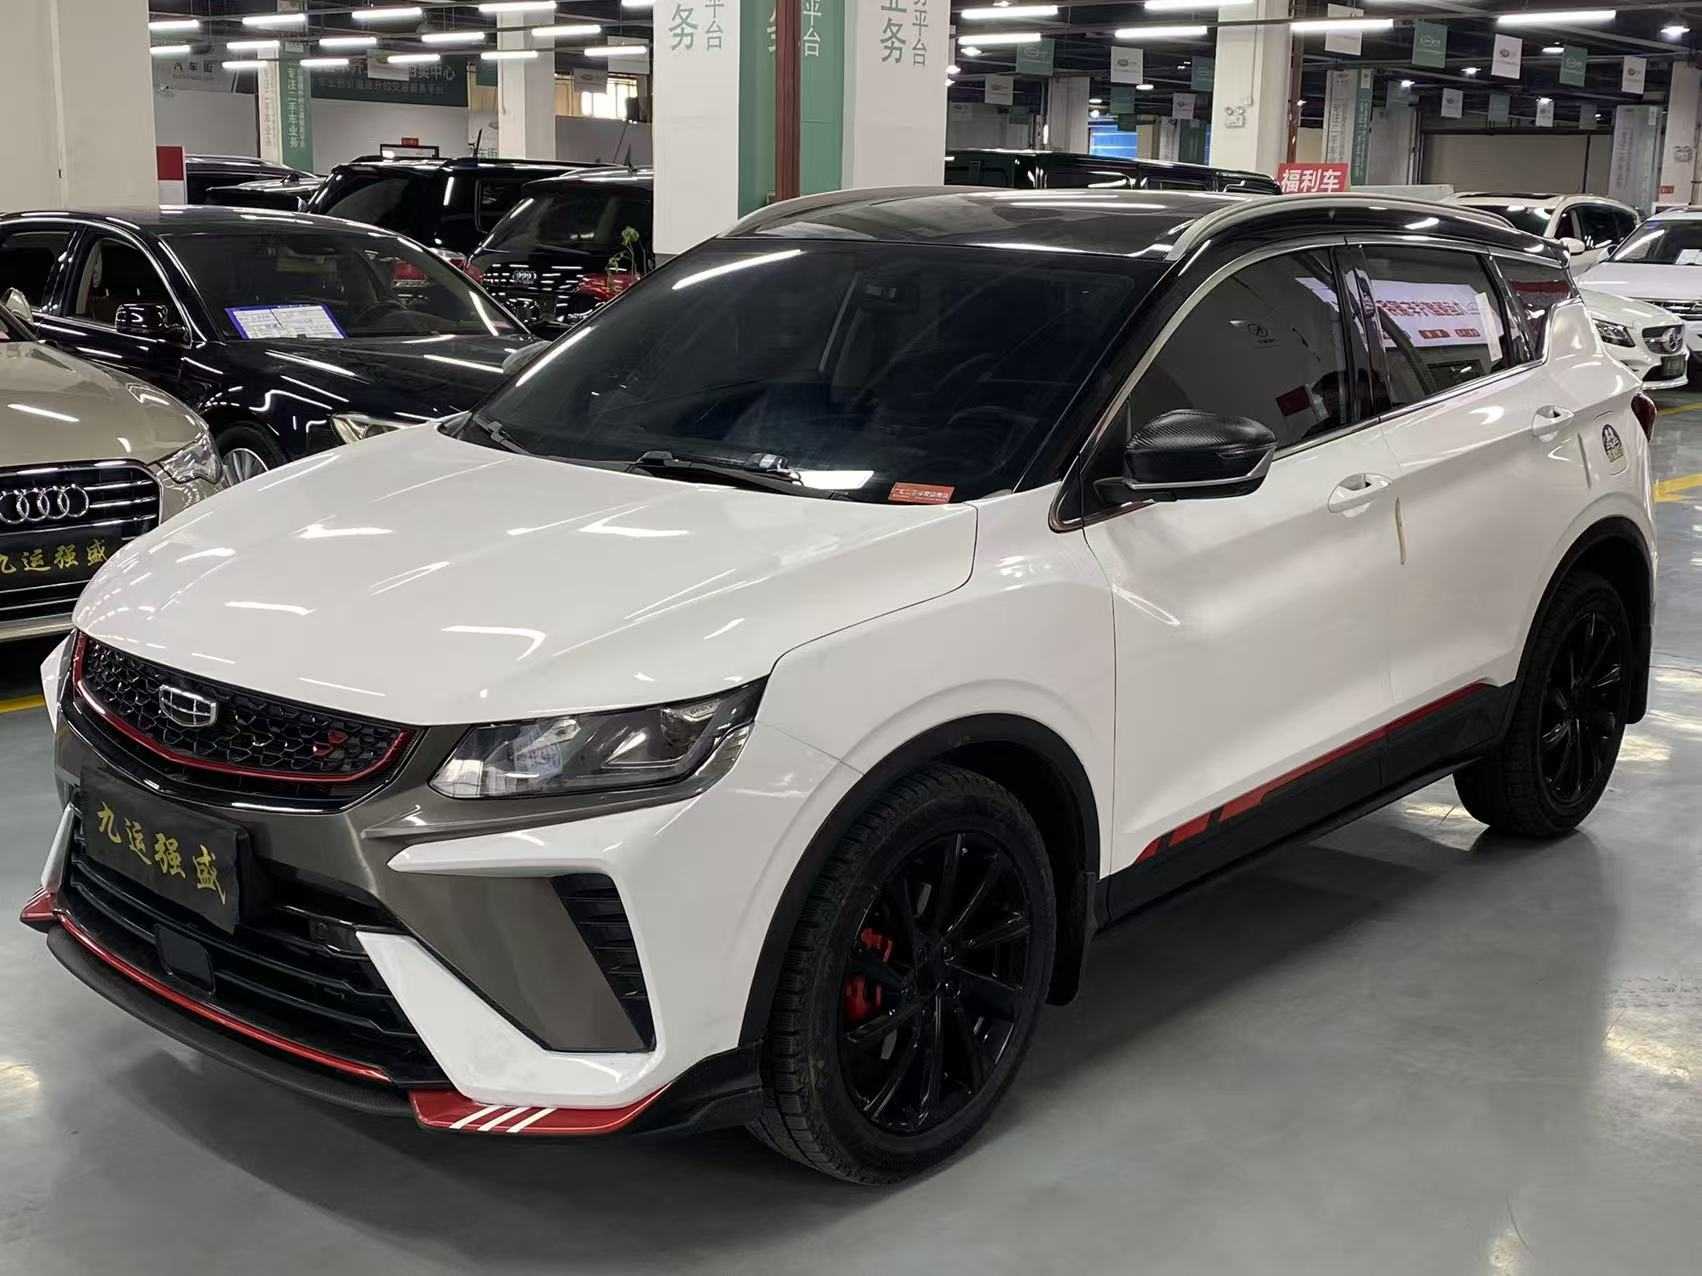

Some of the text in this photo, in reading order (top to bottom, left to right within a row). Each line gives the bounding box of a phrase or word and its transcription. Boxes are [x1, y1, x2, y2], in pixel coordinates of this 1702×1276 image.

[912, 0, 929, 66] 平台
[1280, 168, 1342, 193] 福利车
[97, 801, 226, 904] 九运强盛
